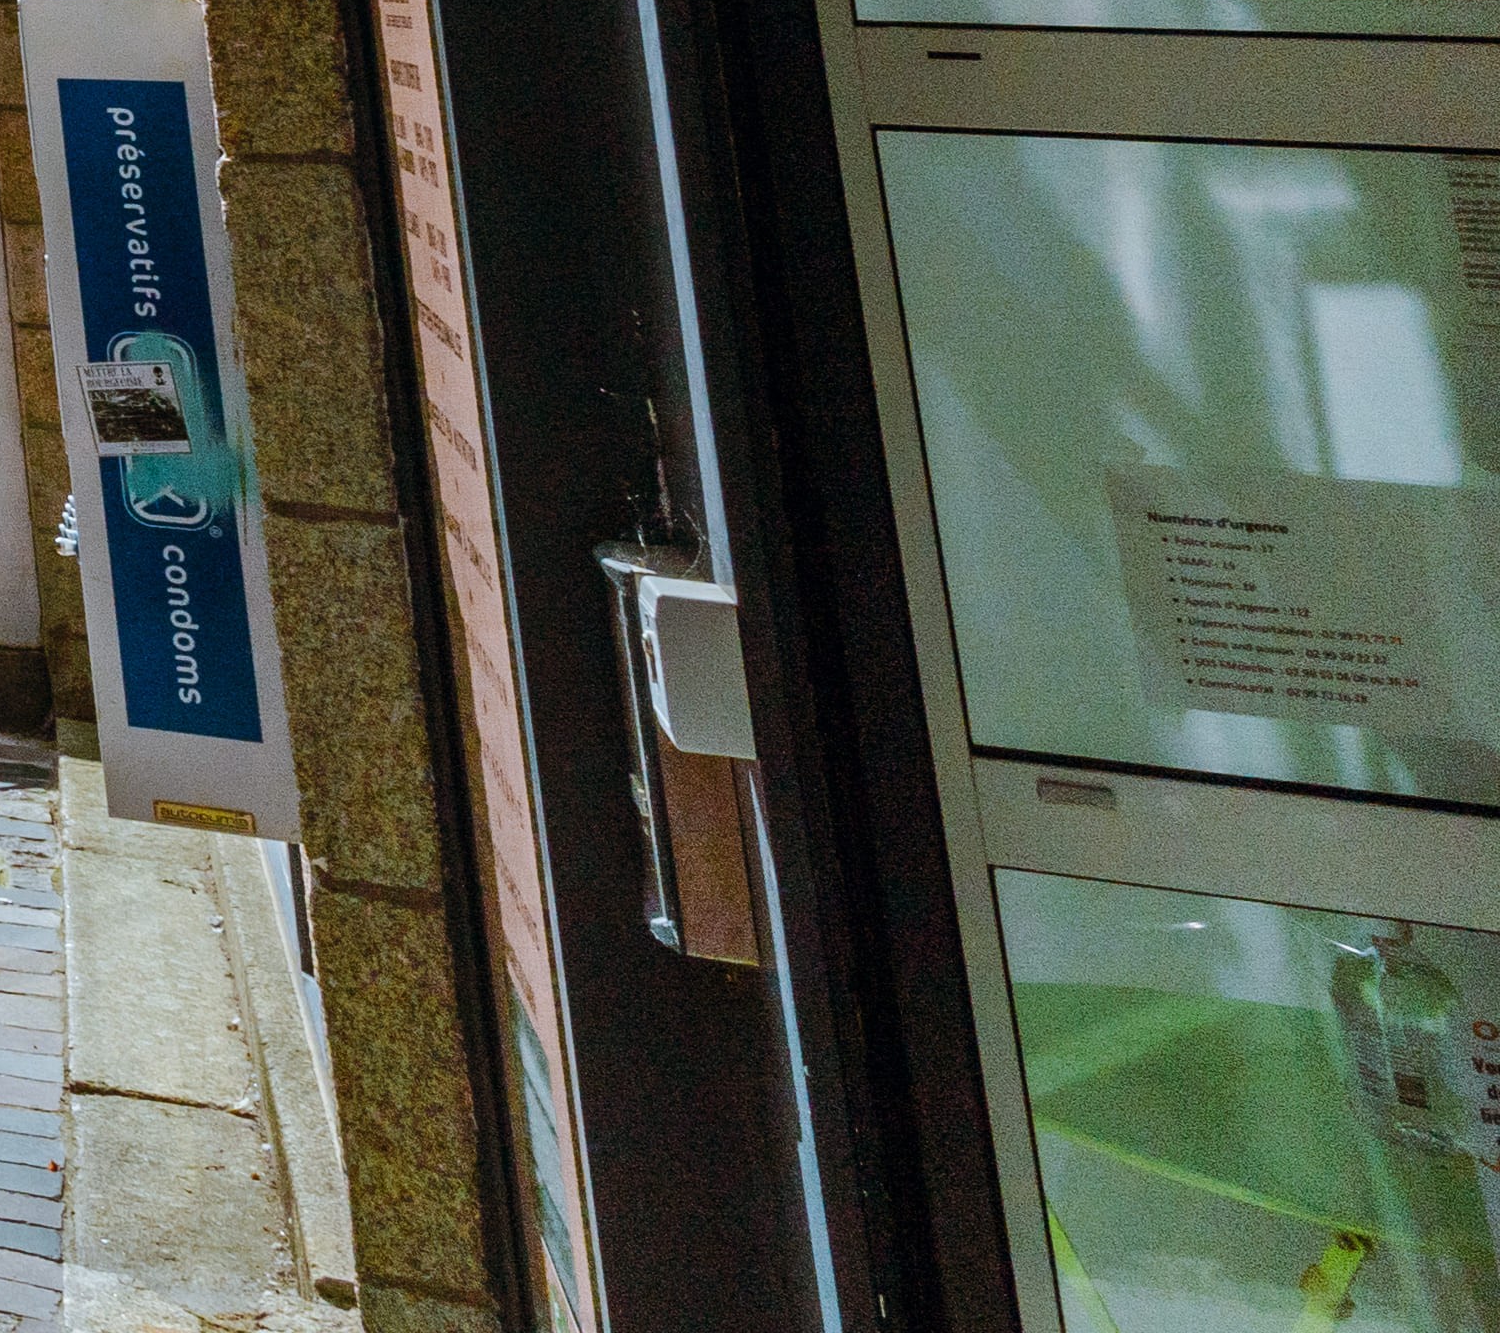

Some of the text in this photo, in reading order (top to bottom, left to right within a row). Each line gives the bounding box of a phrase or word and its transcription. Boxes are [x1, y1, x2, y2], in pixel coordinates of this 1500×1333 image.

[106, 106, 161, 319] préservatifs
[1147, 511, 1289, 534] Numéros d'urgence
[162, 544, 203, 706] condoms
